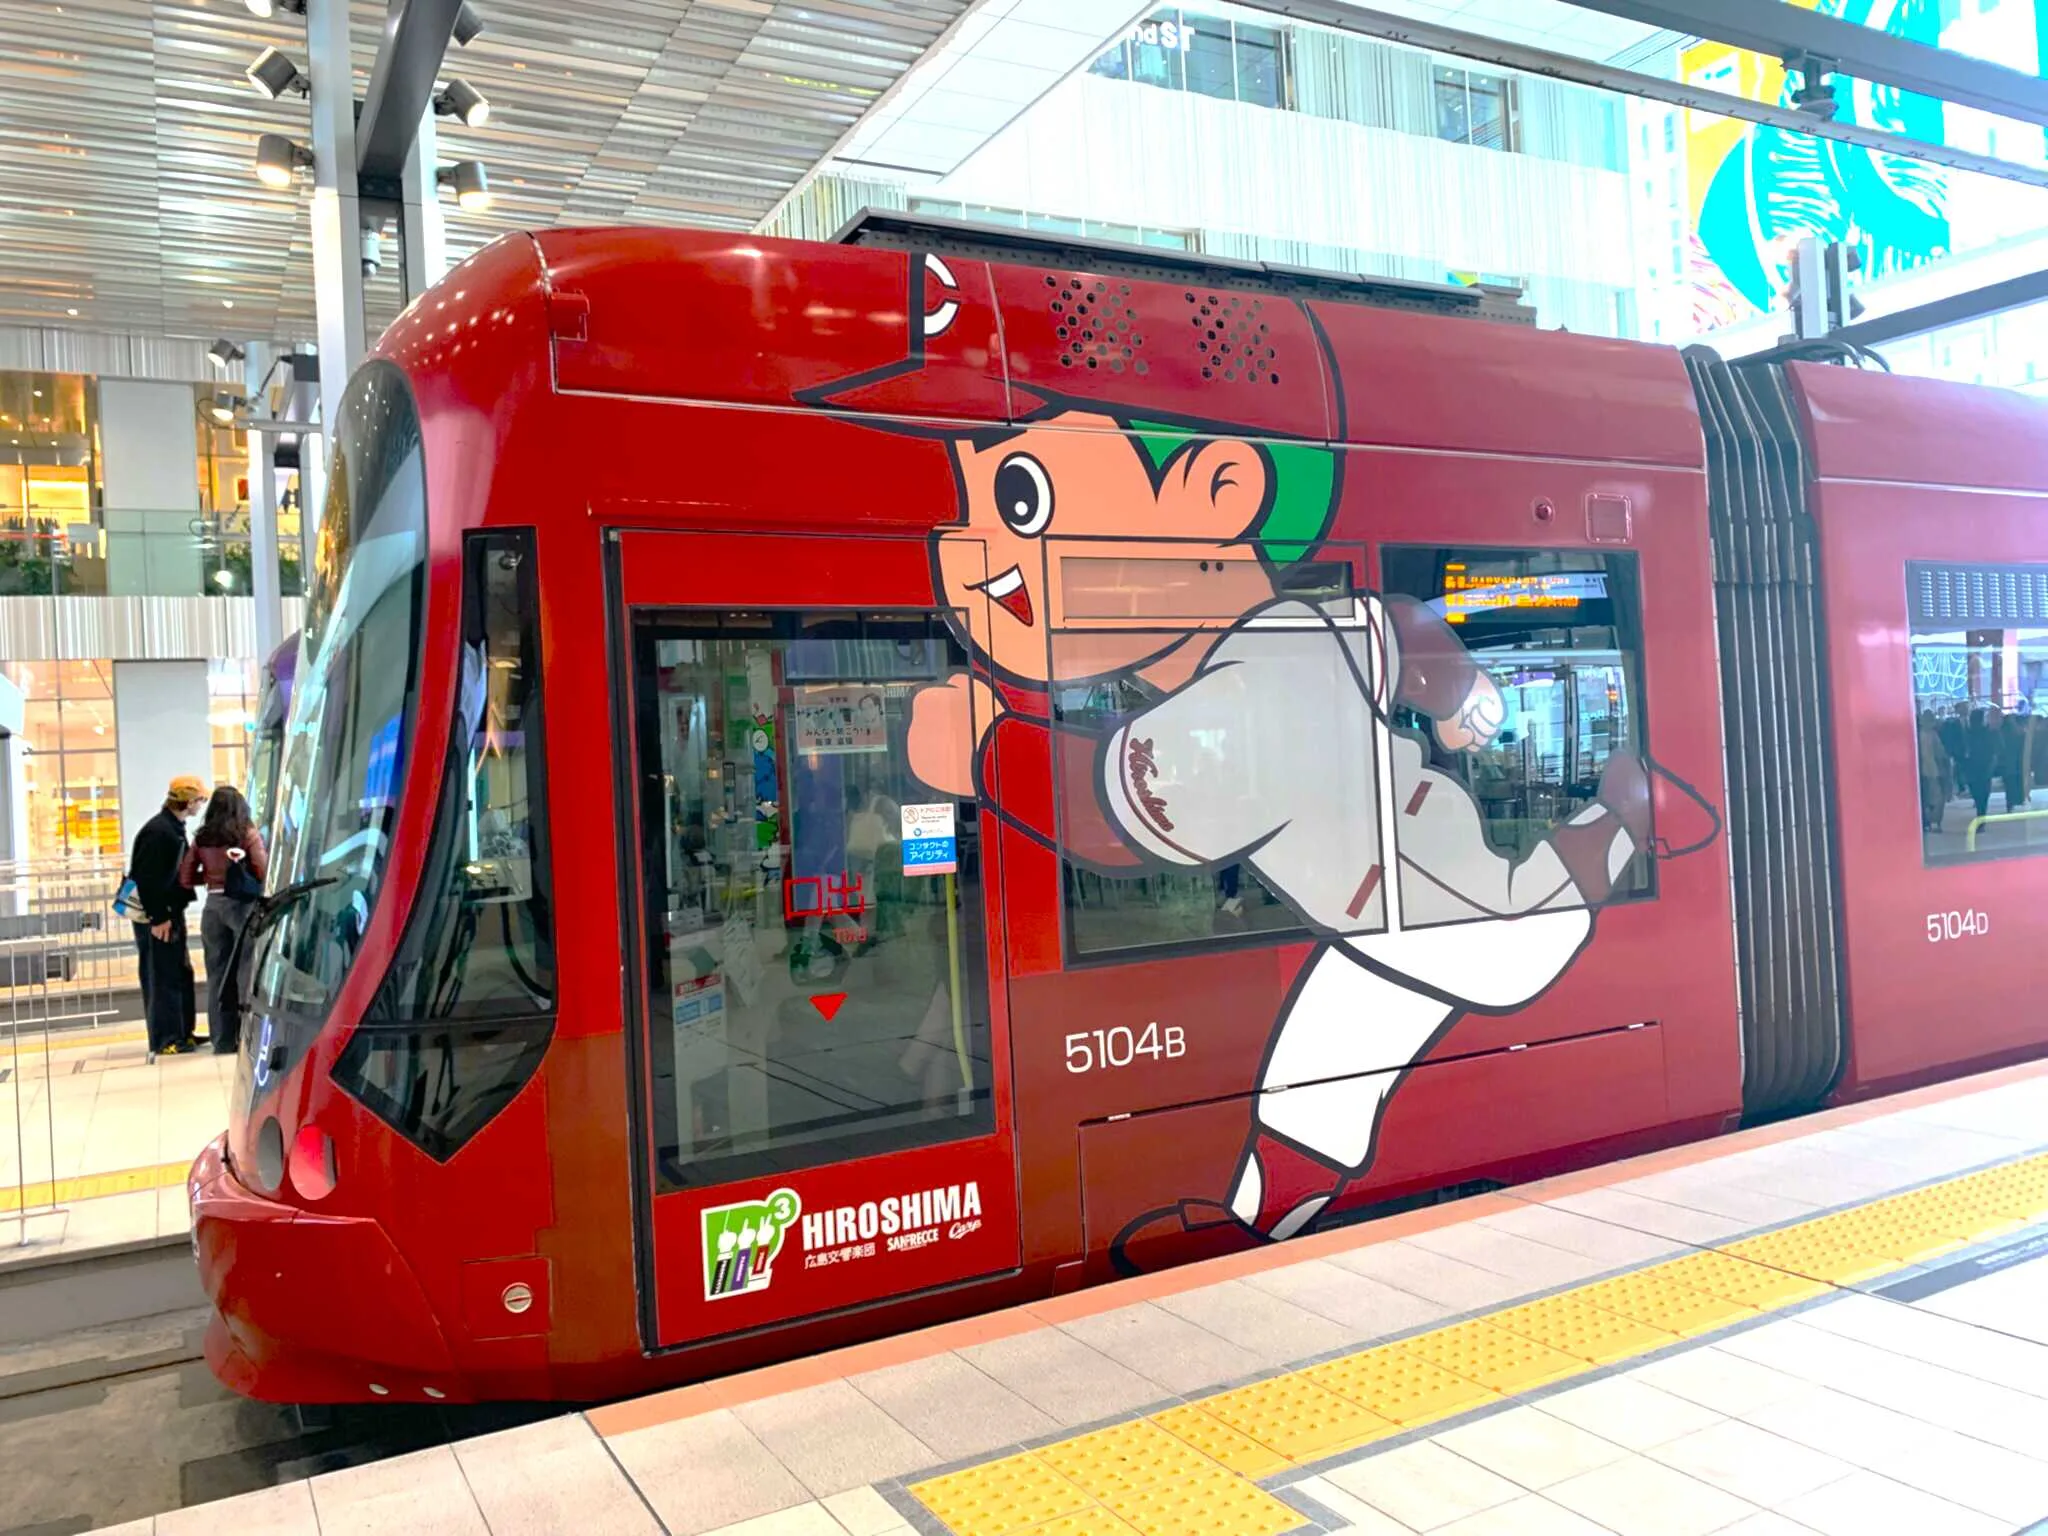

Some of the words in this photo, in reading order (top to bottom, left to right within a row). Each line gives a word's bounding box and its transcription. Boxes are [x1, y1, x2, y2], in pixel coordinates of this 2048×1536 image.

[909, 840, 949, 851] コンタクトの
[909, 849, 949, 862] アイシティ
[1926, 908, 1989, 942] 5104D
[1065, 1022, 1186, 1073] 5104B
[802, 1181, 982, 1250] HIROSHIMA
[887, 1228, 939, 1252] SANFRECCE
[948, 1219, 982, 1240] Carp
[804, 1242, 876, 1270] 広島交響楽団
